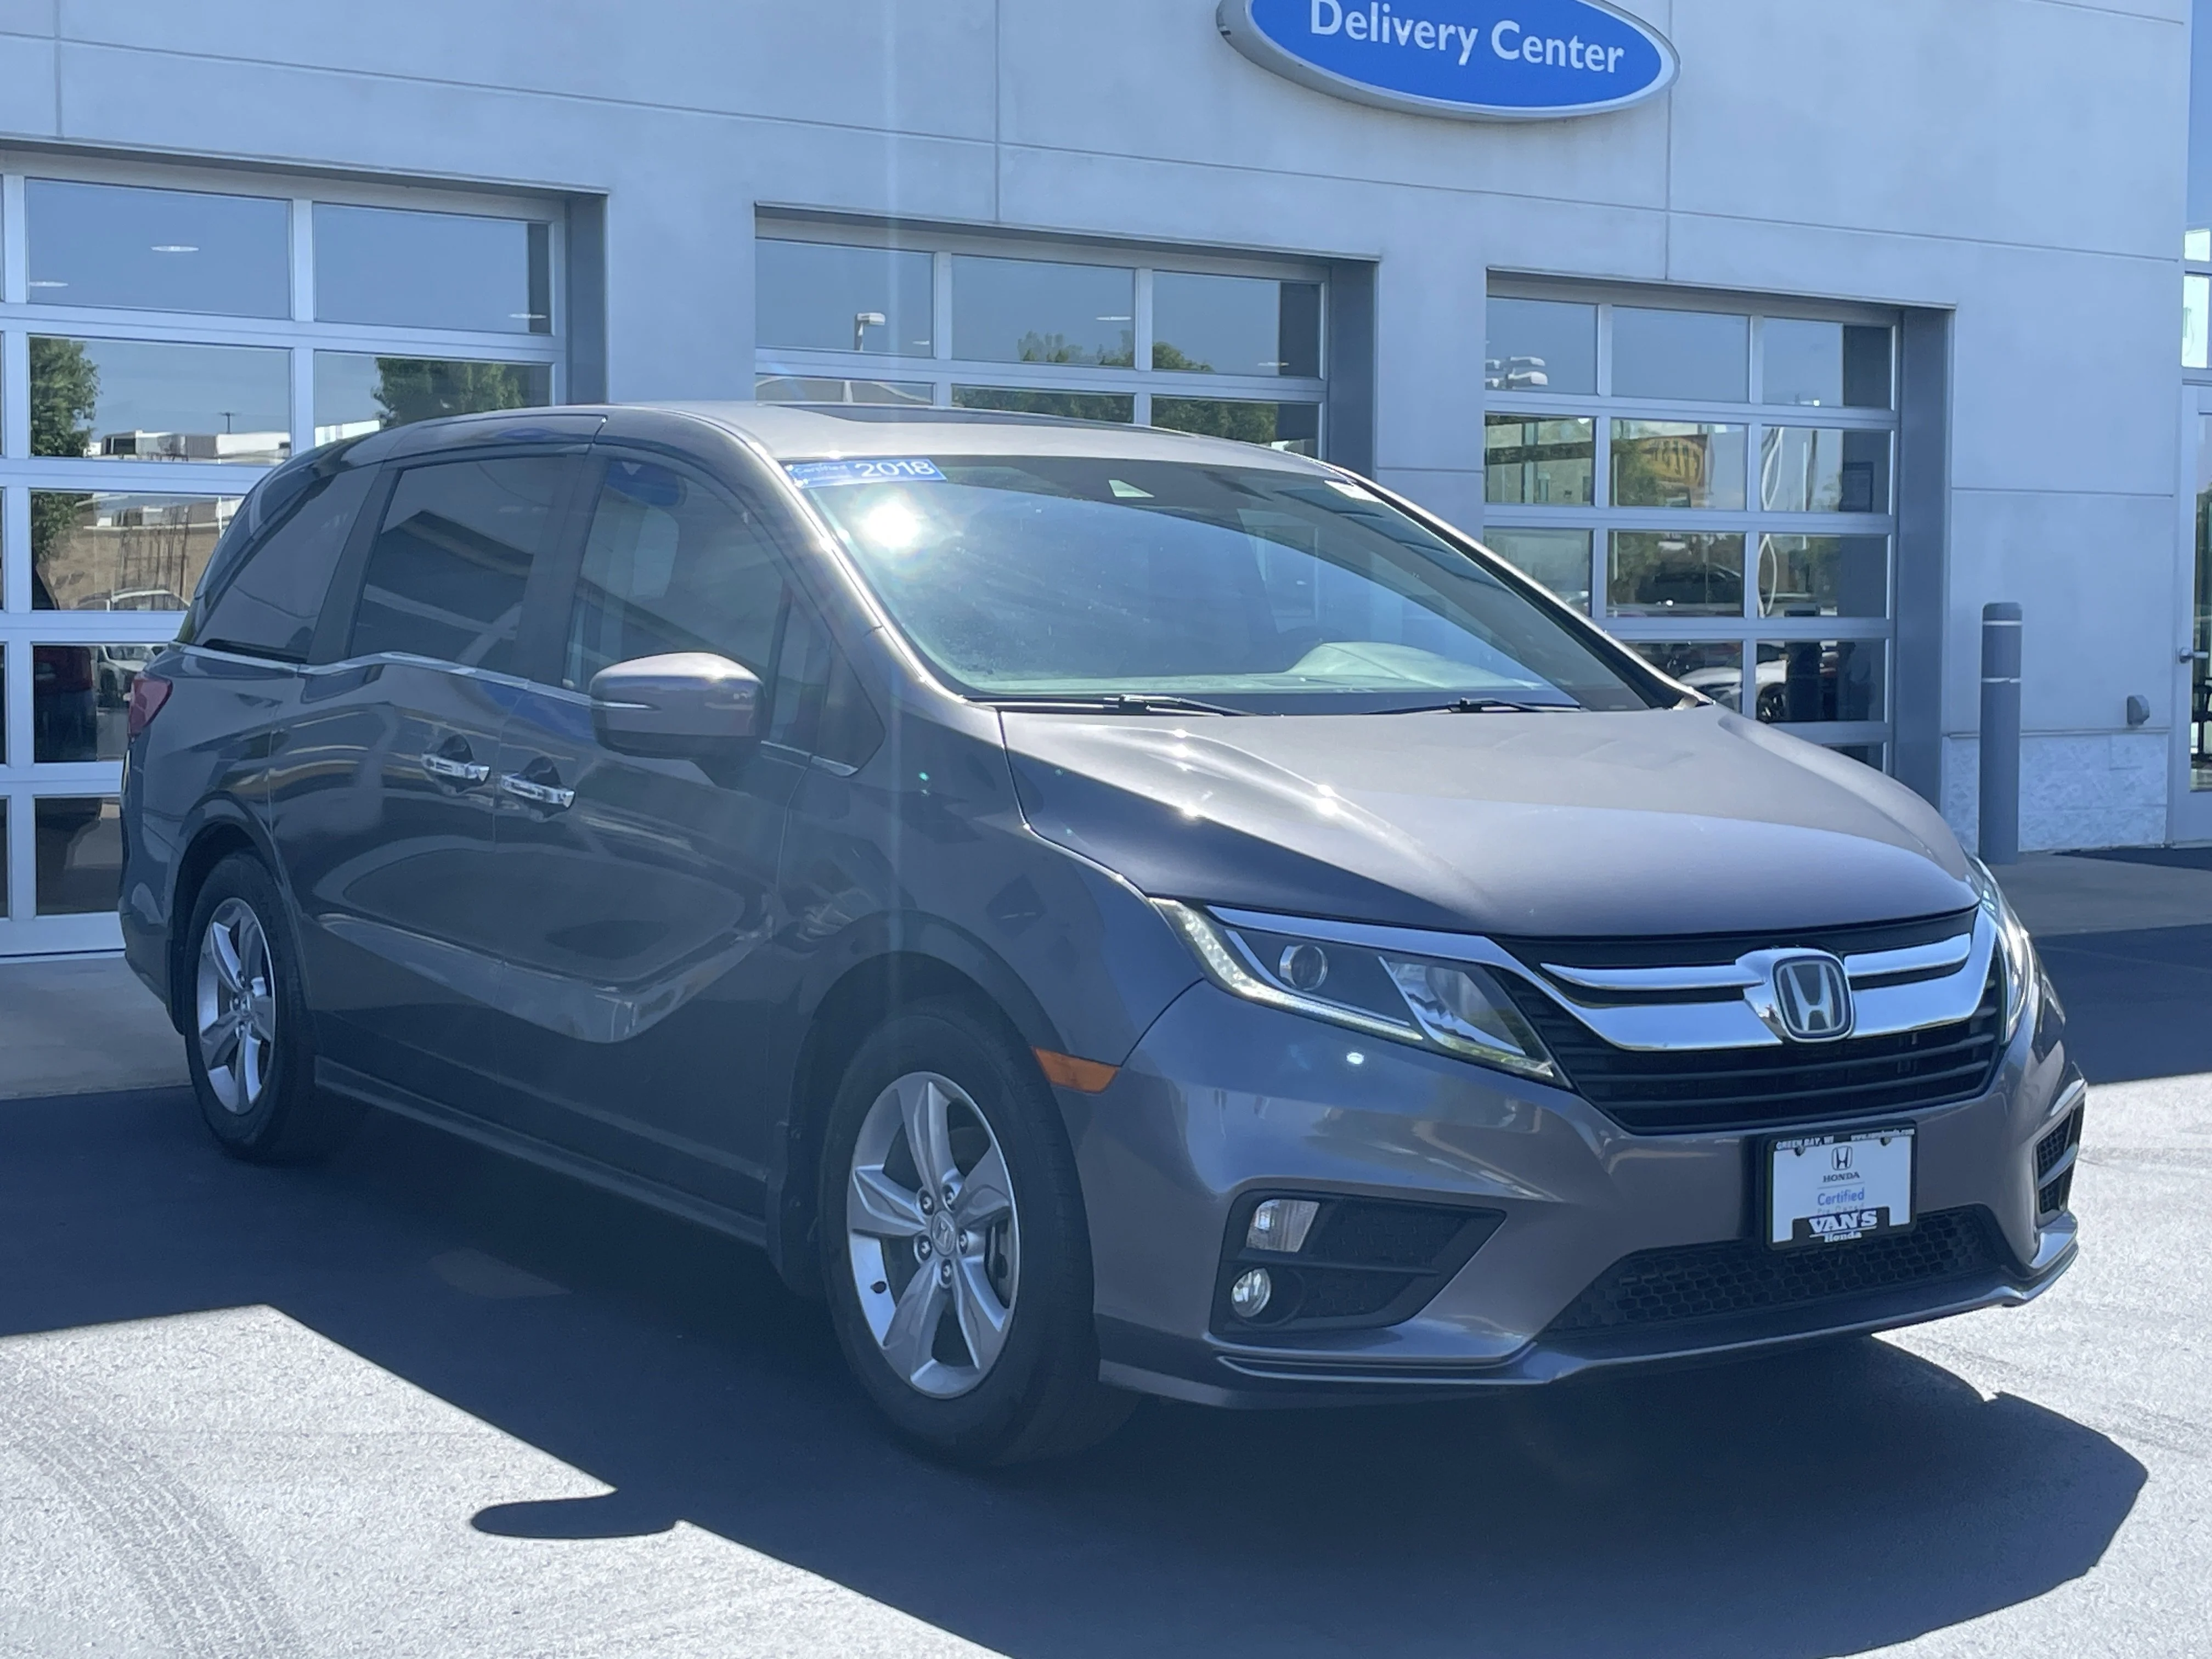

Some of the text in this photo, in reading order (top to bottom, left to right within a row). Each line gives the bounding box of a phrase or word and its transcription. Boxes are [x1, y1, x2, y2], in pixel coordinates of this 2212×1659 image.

[1310, 0, 1624, 74] Delivery Center
[854, 460, 936, 477] 2018
[1822, 1171, 1860, 1183] HONDA
[1817, 1187, 1865, 1206] Certified
[1824, 1231, 1863, 1243] Honda
